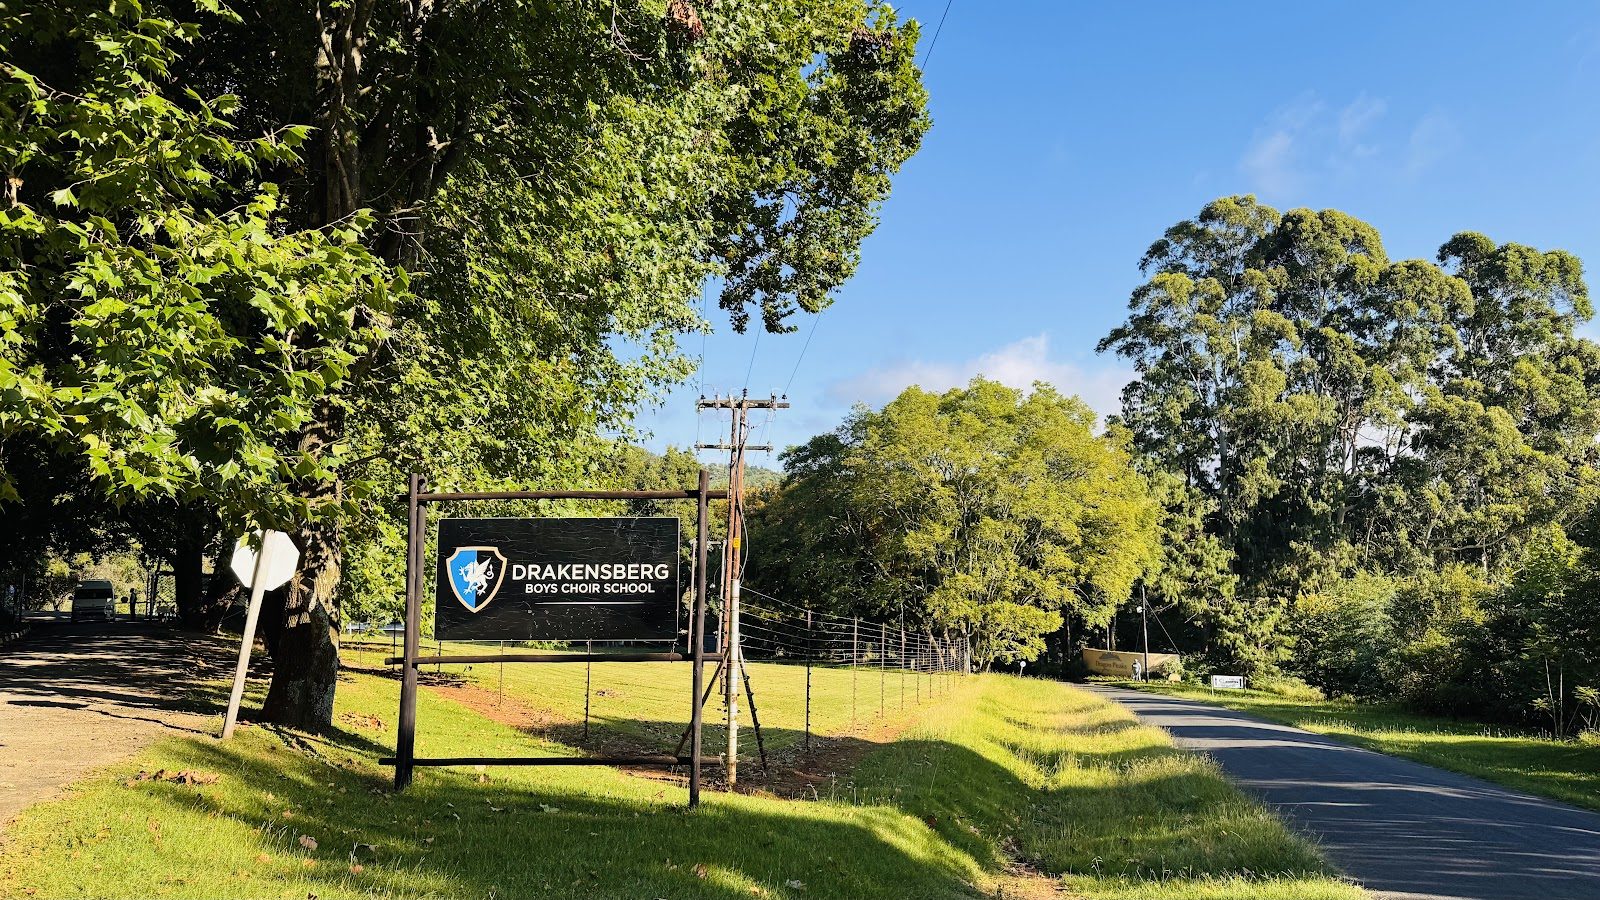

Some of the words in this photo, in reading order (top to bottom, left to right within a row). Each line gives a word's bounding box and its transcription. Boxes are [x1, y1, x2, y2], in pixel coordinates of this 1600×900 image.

[511, 563, 670, 581] DRAKENSBERG
[525, 583, 559, 594] BOYS
[560, 583, 601, 594] CHOIR
[603, 583, 656, 594] SCHOOL
